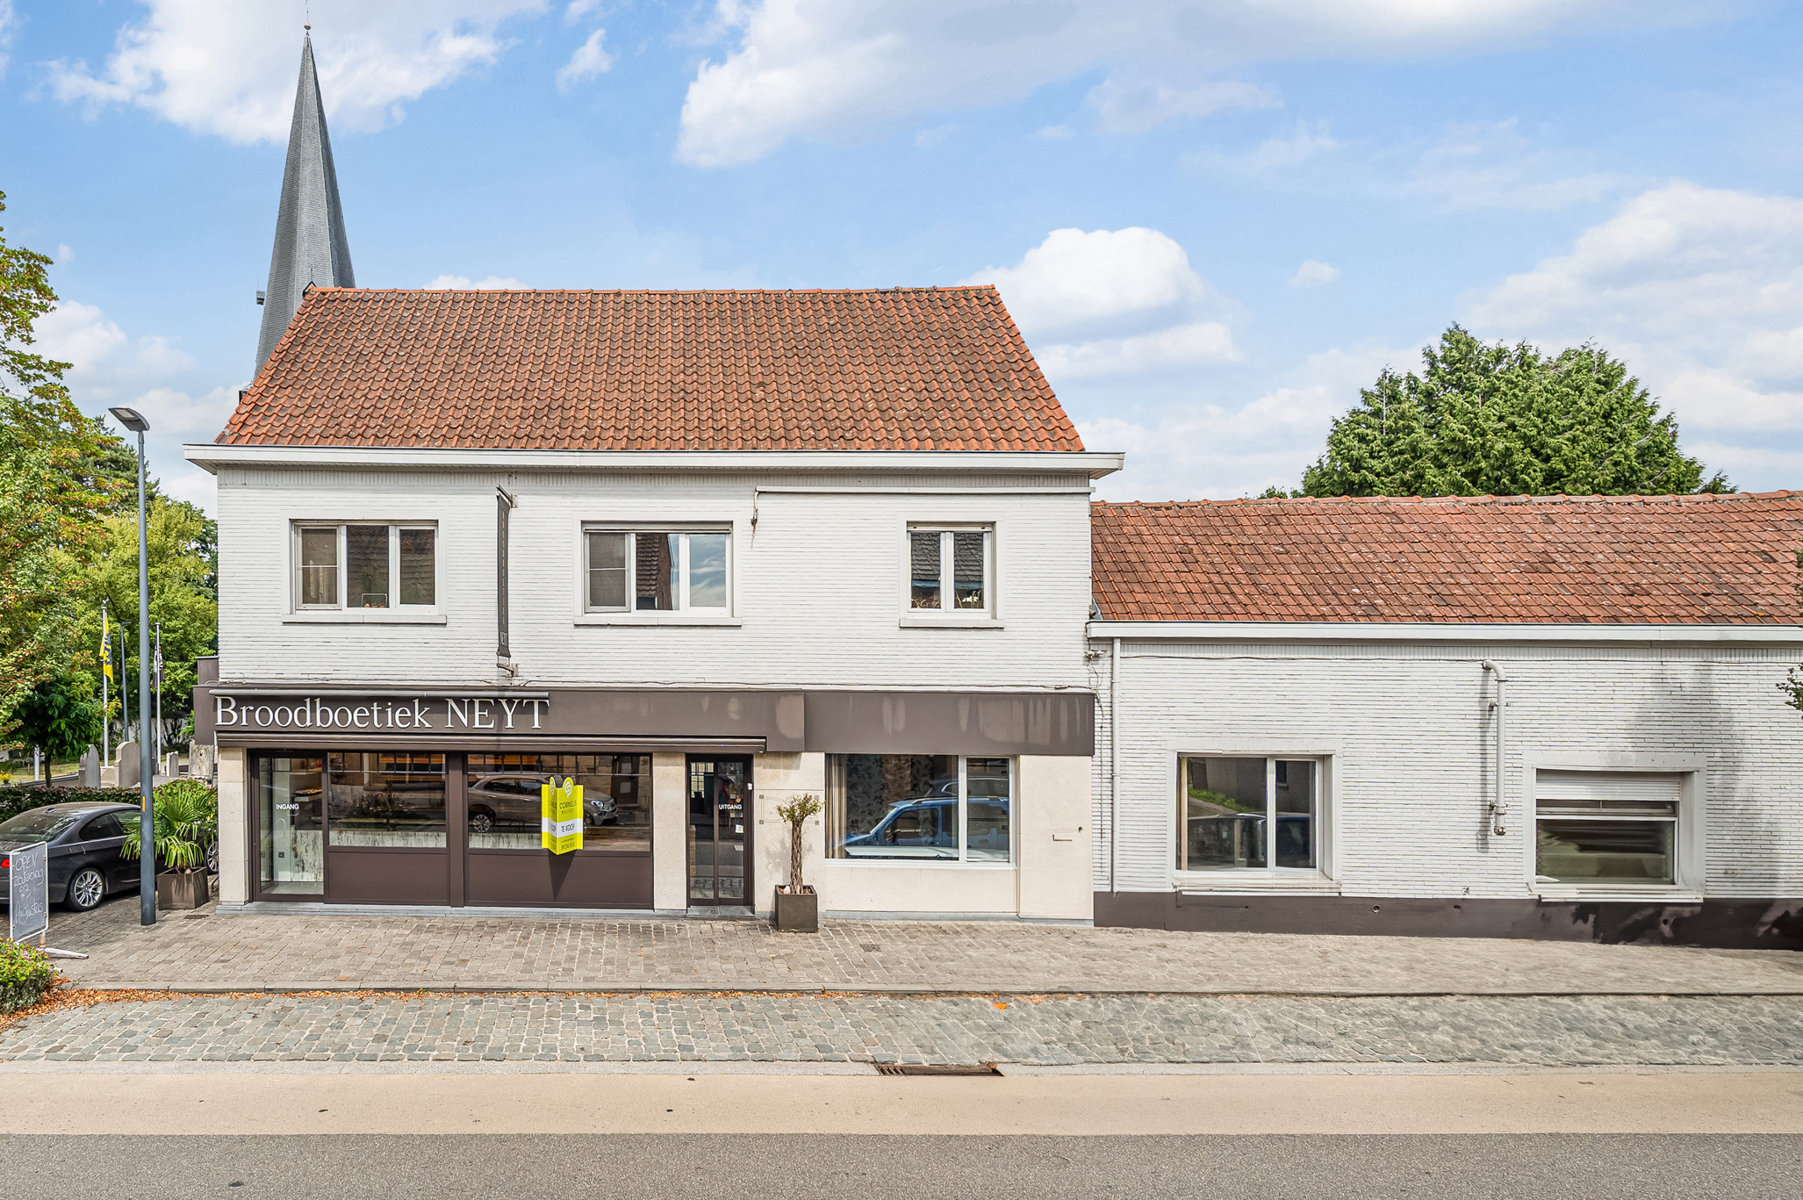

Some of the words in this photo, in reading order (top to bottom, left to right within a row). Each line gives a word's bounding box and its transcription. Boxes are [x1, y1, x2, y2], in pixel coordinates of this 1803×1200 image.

[214, 695, 433, 729] Broodboetiek
[444, 698, 550, 729] NEYT
[15, 851, 38, 871] OPEN
